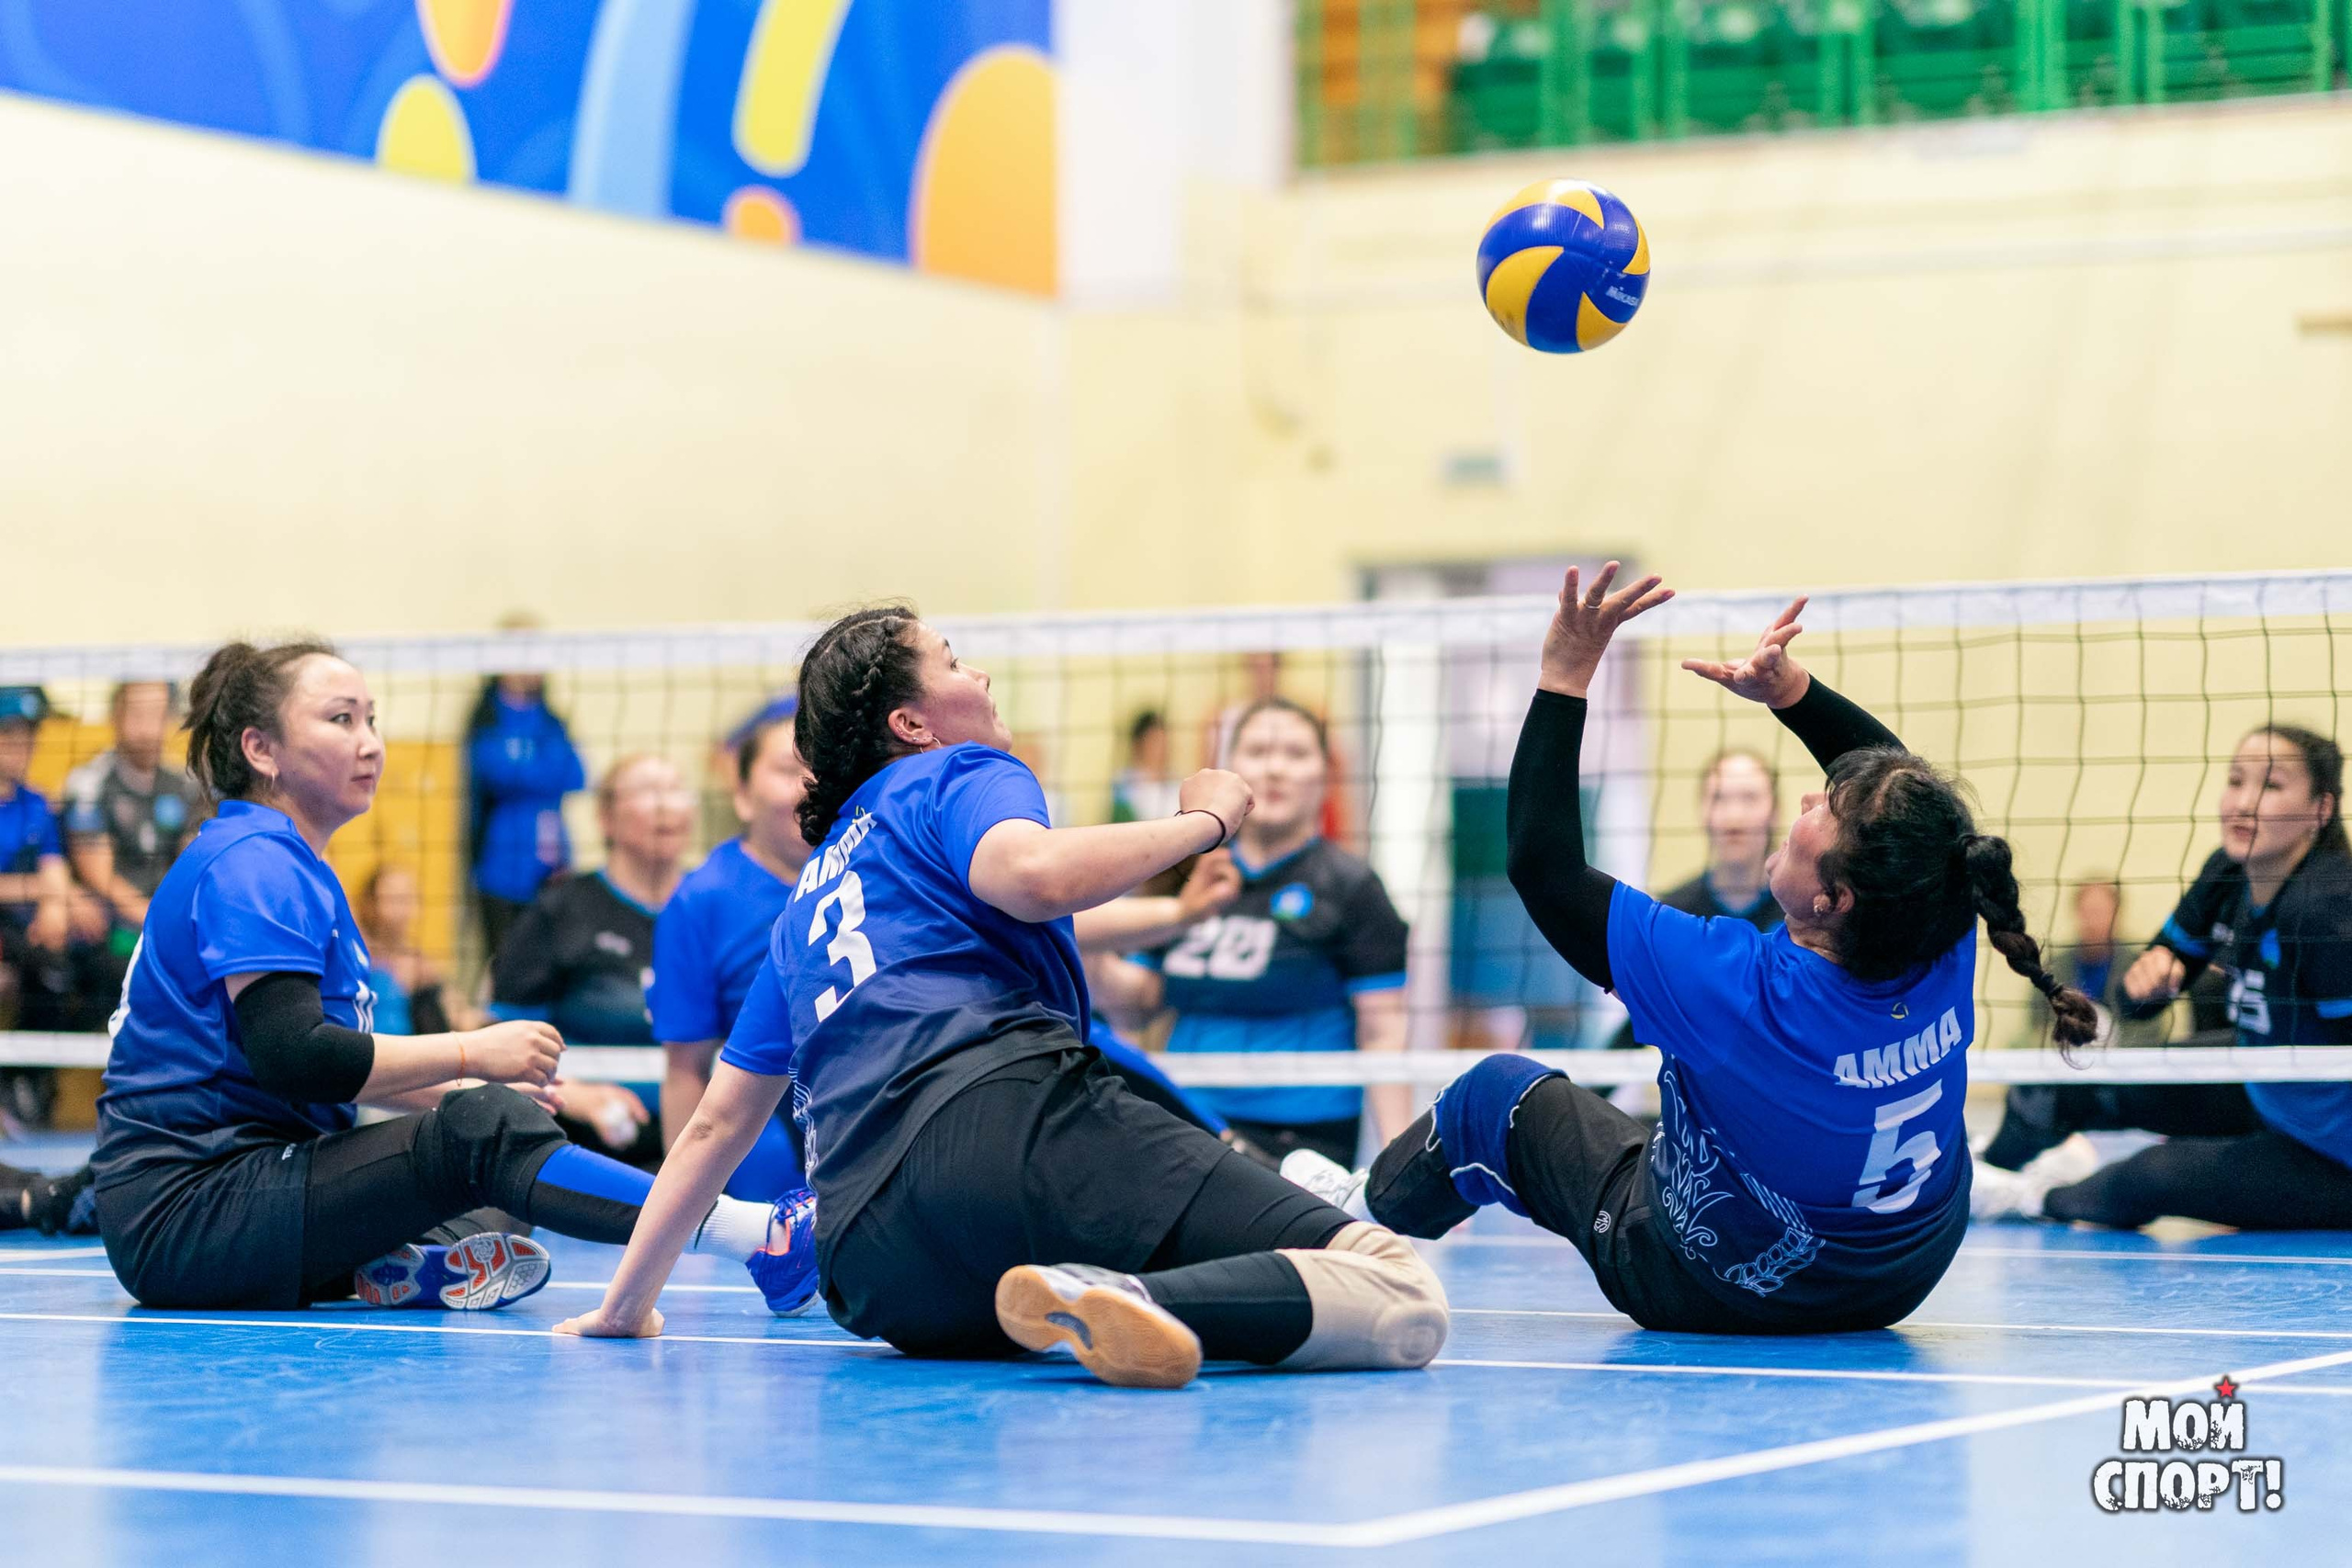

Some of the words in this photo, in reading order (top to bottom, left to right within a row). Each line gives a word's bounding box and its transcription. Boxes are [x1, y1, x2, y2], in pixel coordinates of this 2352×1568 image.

[808, 870, 876, 1023] 3
[1834, 1006, 1962, 1089] AMMA
[1851, 1078, 1943, 1213] 5
